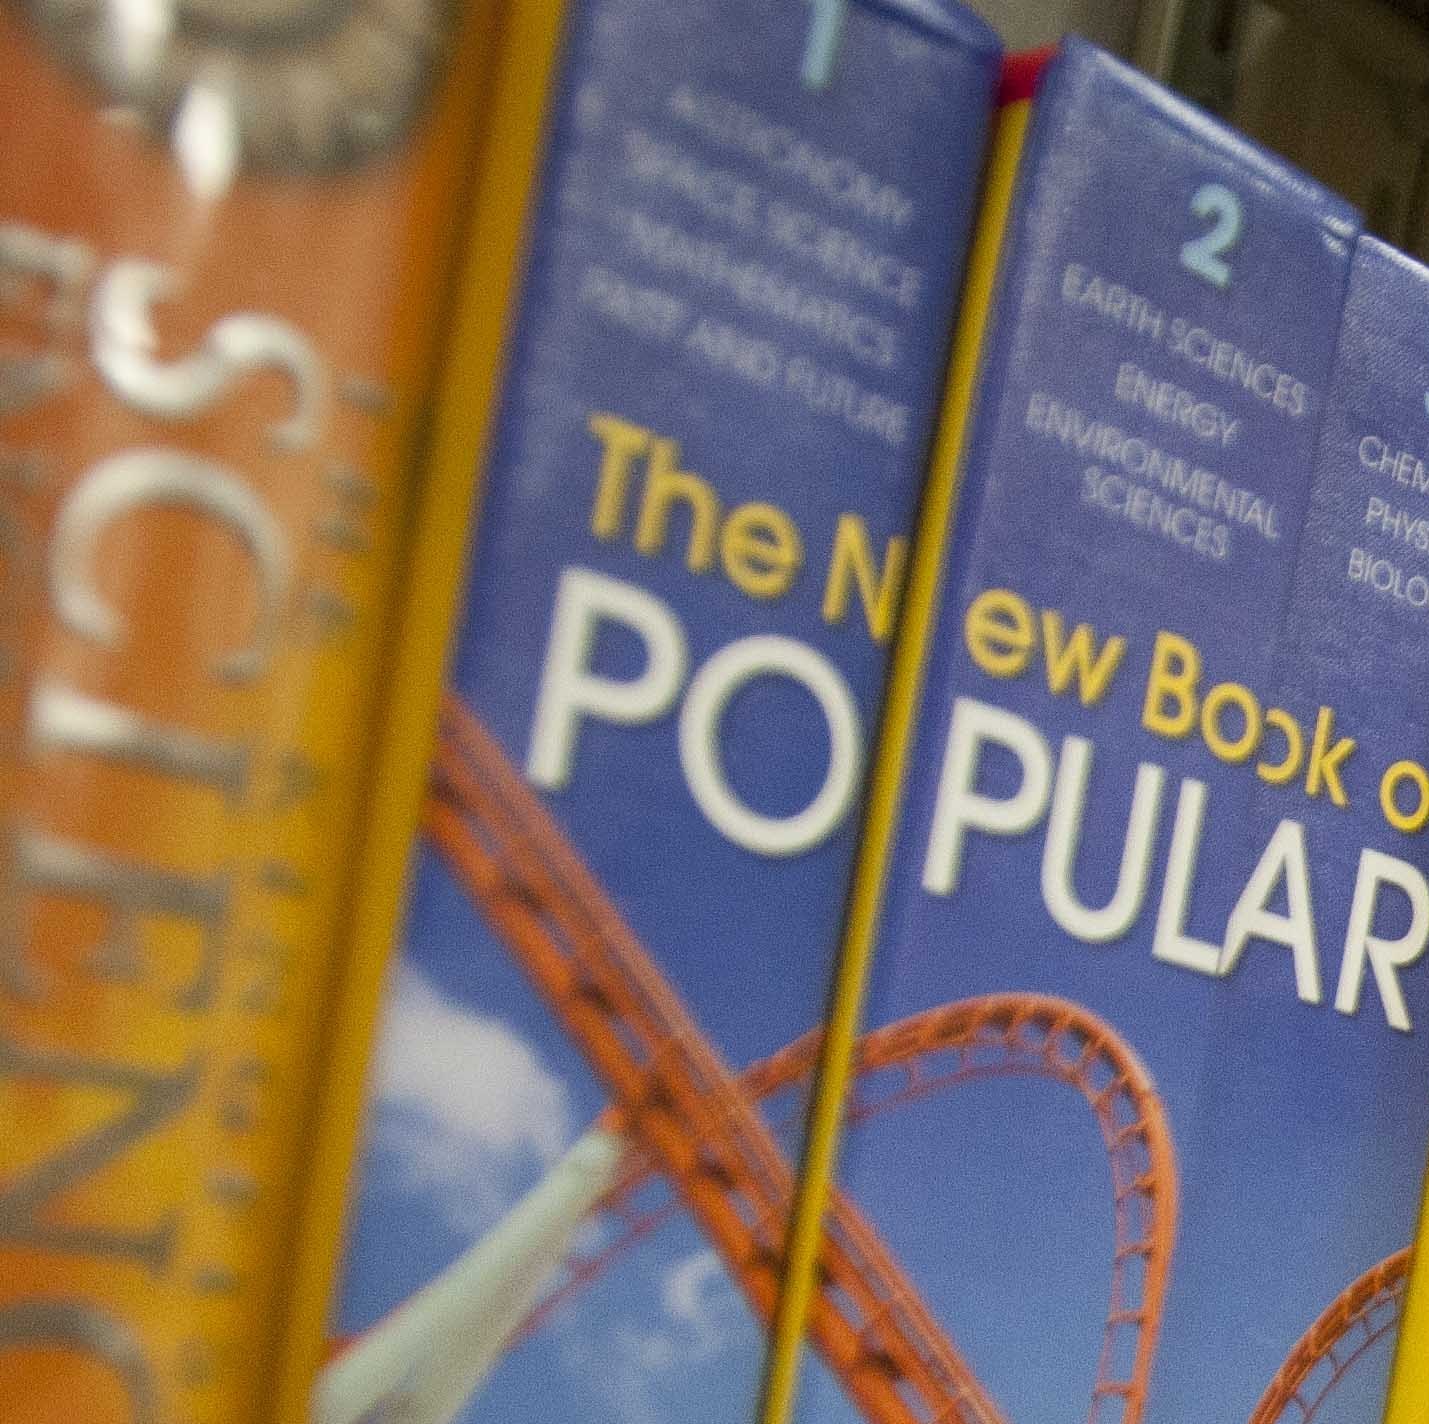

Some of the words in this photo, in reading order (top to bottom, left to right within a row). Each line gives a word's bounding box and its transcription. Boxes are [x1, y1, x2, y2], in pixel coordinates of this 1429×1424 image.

[1180, 184, 1243, 289] 2
[1061, 262, 1169, 350] EARTH
[1172, 315, 1310, 417] SCIENCES
[1113, 362, 1243, 447] ENERGY
[588, 413, 804, 597] The
[1023, 396, 1282, 541] ENVIRONMENTAL
[1081, 465, 1233, 563] SCIENCES
